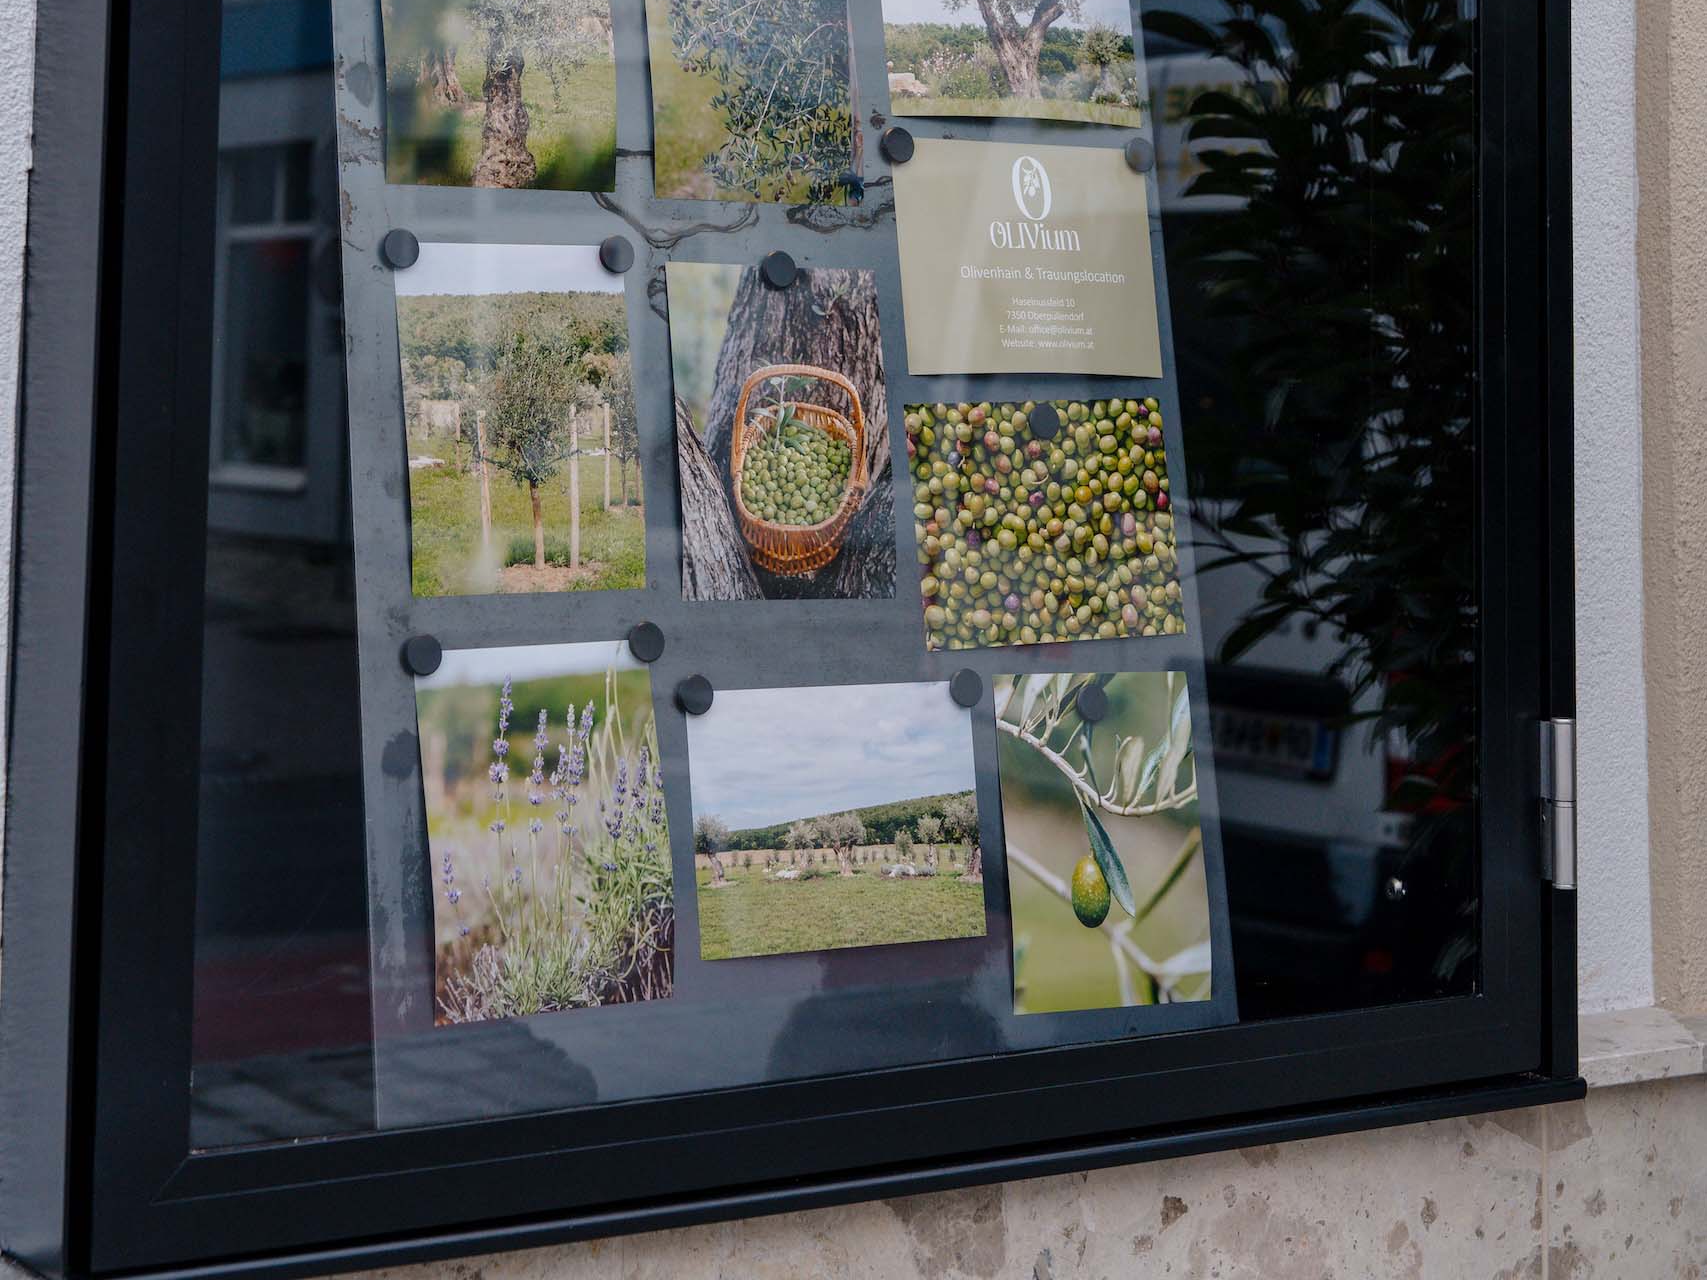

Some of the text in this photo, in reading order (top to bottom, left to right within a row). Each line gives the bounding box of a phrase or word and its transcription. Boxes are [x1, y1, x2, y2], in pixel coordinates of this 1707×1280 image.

[989, 220, 1081, 252] OLIVium
[960, 265, 1126, 285] Olivenhain & Trauungslocation
[1065, 297, 1076, 308] 10
[1006, 310, 1026, 320] 7350
[999, 324, 1026, 335] E-Mail:
[1001, 338, 1036, 349] Website:
